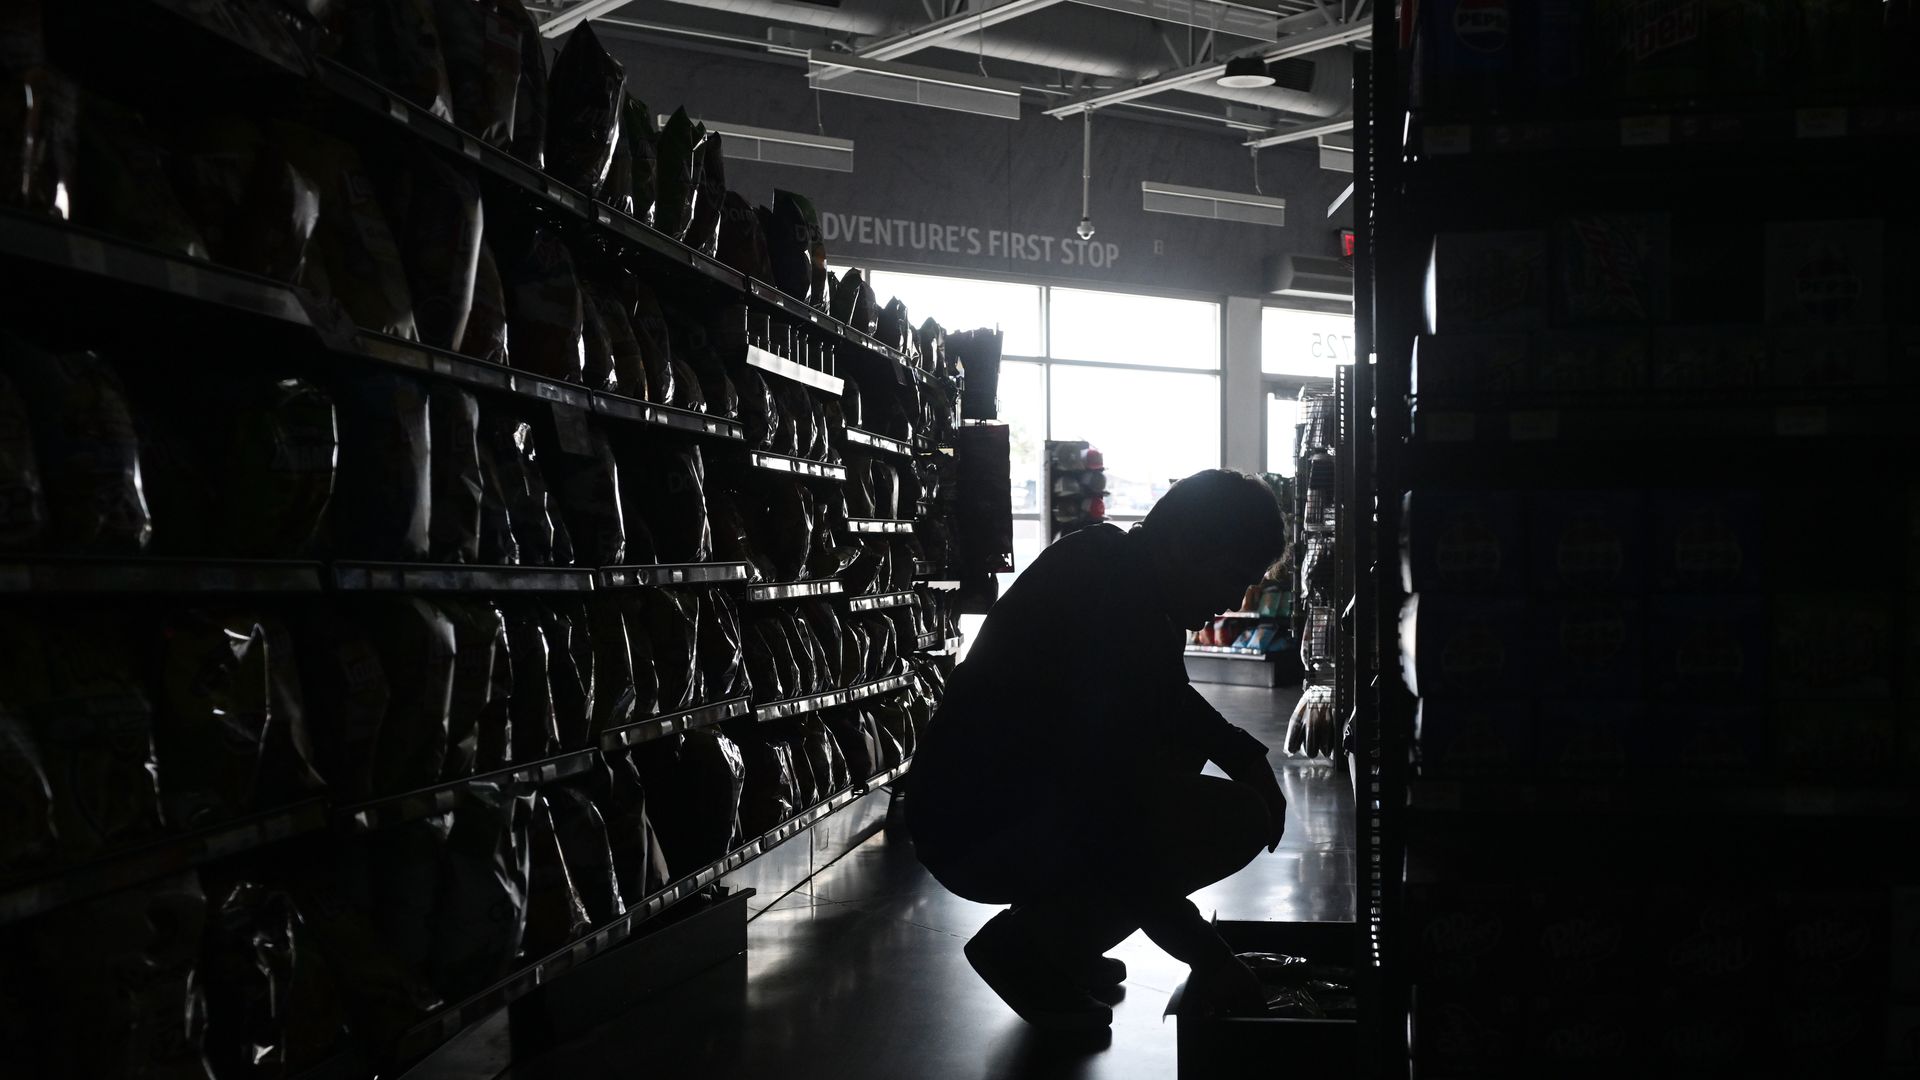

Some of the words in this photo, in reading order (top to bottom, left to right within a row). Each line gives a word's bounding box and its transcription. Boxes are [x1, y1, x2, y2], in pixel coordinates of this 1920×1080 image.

[821, 211, 982, 255] DVENTURE'S
[988, 229, 1055, 262] FIRST
[1060, 238, 1120, 269] STOP
